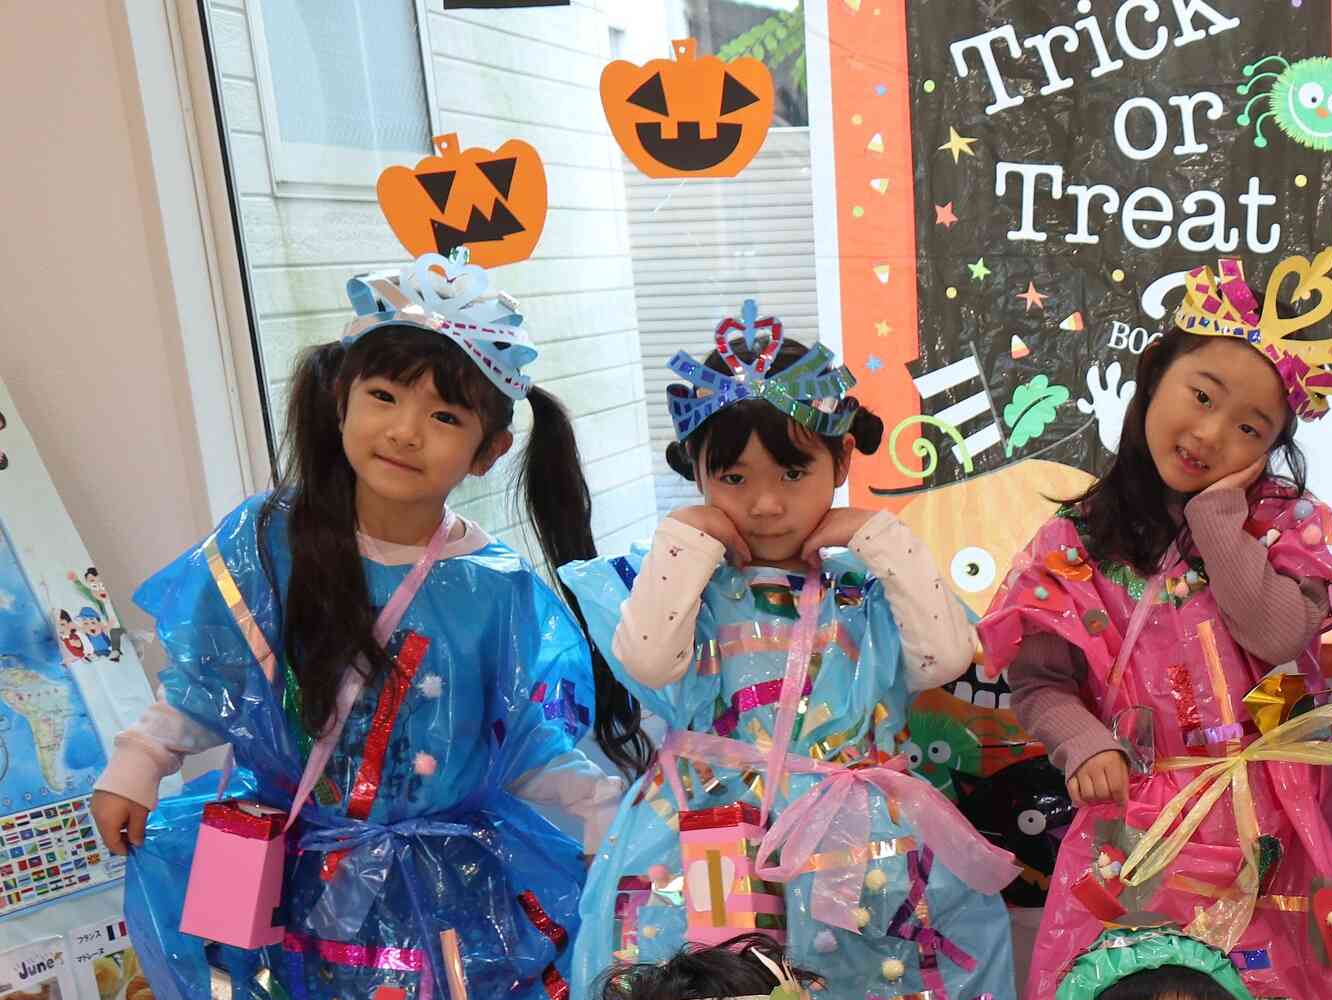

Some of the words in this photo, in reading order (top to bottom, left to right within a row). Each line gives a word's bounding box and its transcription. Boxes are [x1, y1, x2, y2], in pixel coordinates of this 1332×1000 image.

[950, 0, 1240, 115] Trick
[1114, 91, 1224, 160] or
[995, 161, 1281, 253] Treat
[19, 958, 55, 980] June
